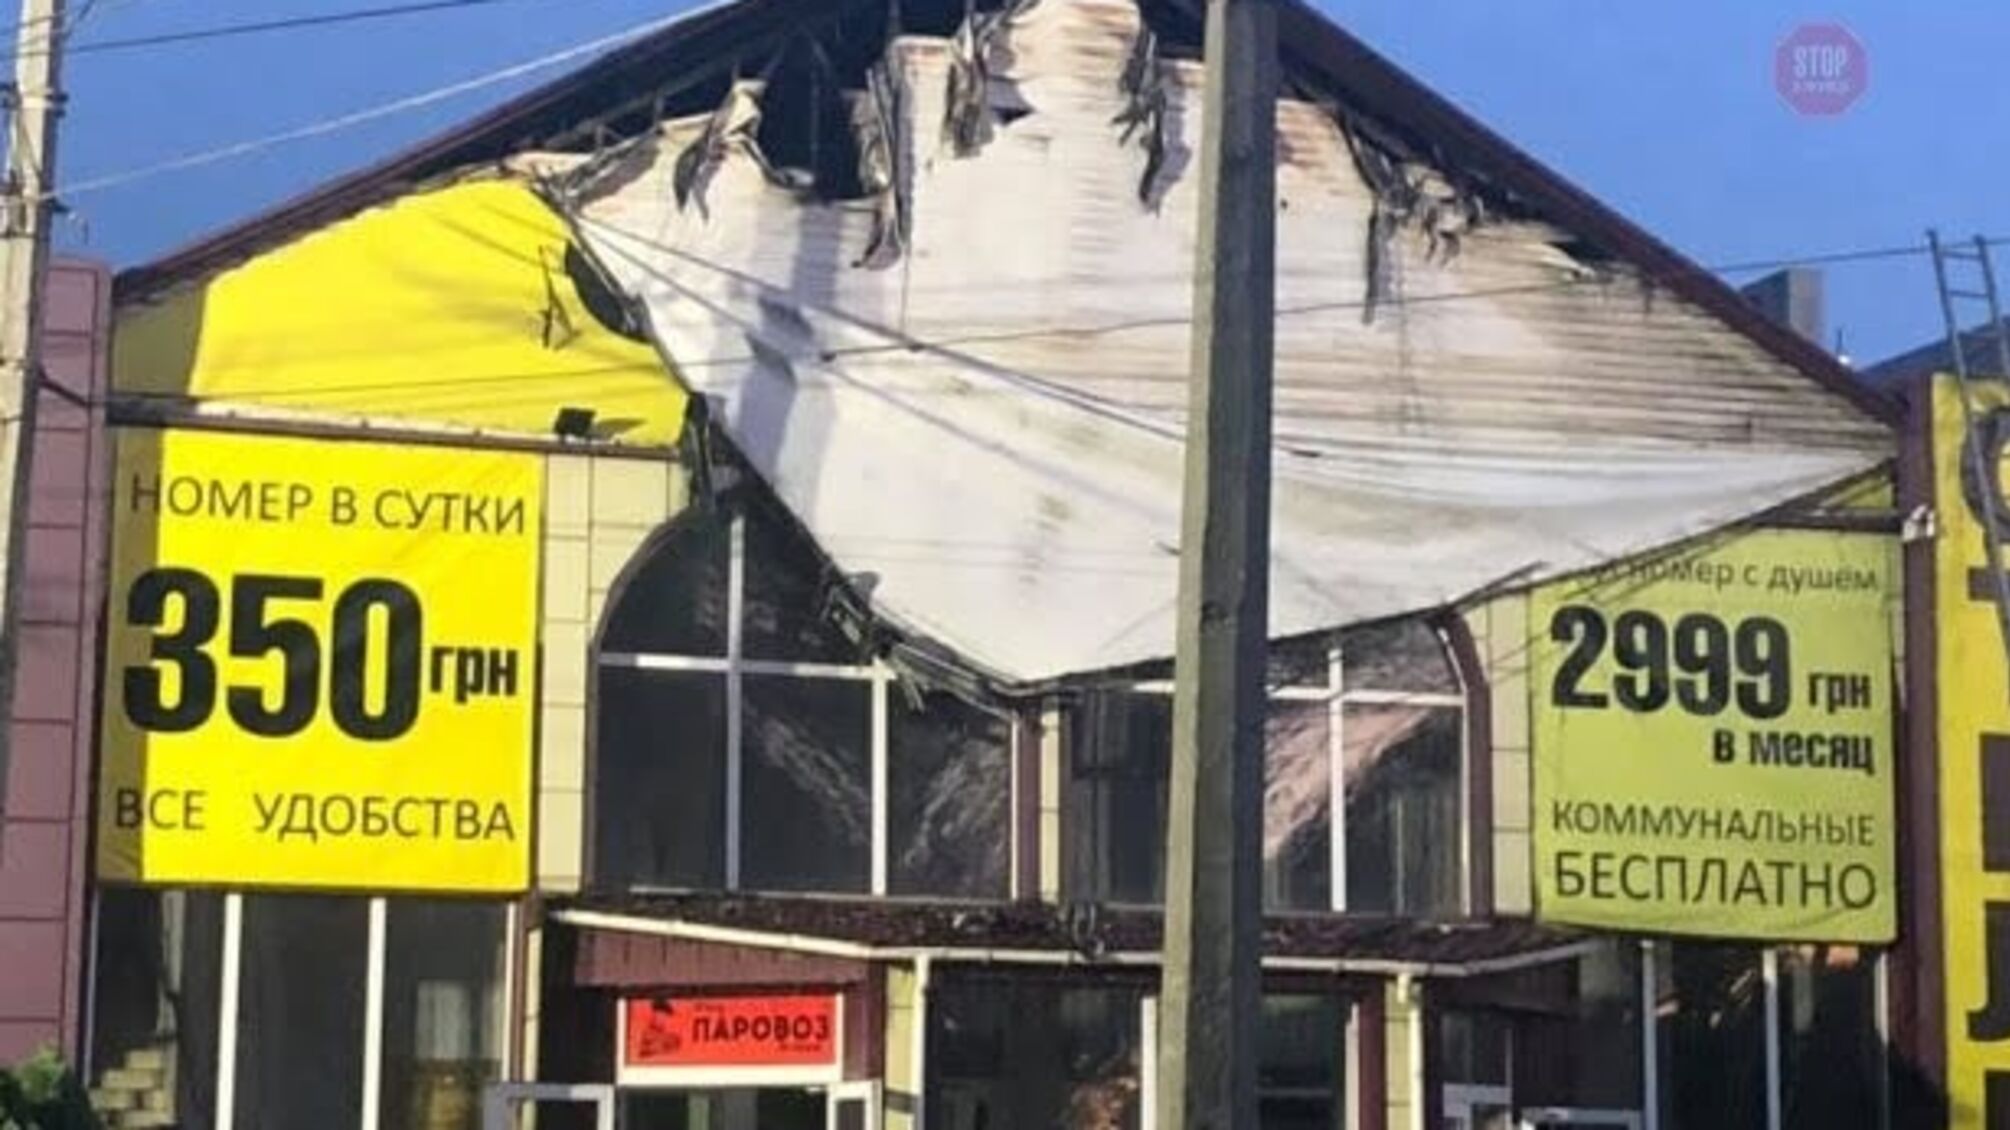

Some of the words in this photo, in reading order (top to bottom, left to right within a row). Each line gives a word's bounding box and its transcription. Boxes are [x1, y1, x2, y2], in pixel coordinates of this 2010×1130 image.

[131, 473, 313, 523] НОМЕР
[331, 486, 358, 525] В
[374, 489, 525, 535] СУТКИ
[1743, 564, 1759, 587] с
[1766, 565, 1879, 595] душем
[122, 566, 423, 742] 350
[429, 645, 518, 704] грн
[1550, 604, 1792, 720] 2999
[1808, 672, 1871, 714] грн
[1749, 731, 1875, 775] месяц
[115, 788, 207, 832] ВСЕ
[253, 792, 515, 842] УДОБСТВА
[1552, 801, 1875, 847] КОММУНАЛЬНЫЕ
[1555, 850, 1877, 910] БЕСПЛАТНО
[691, 1014, 830, 1042] ПАРОВОЗ
